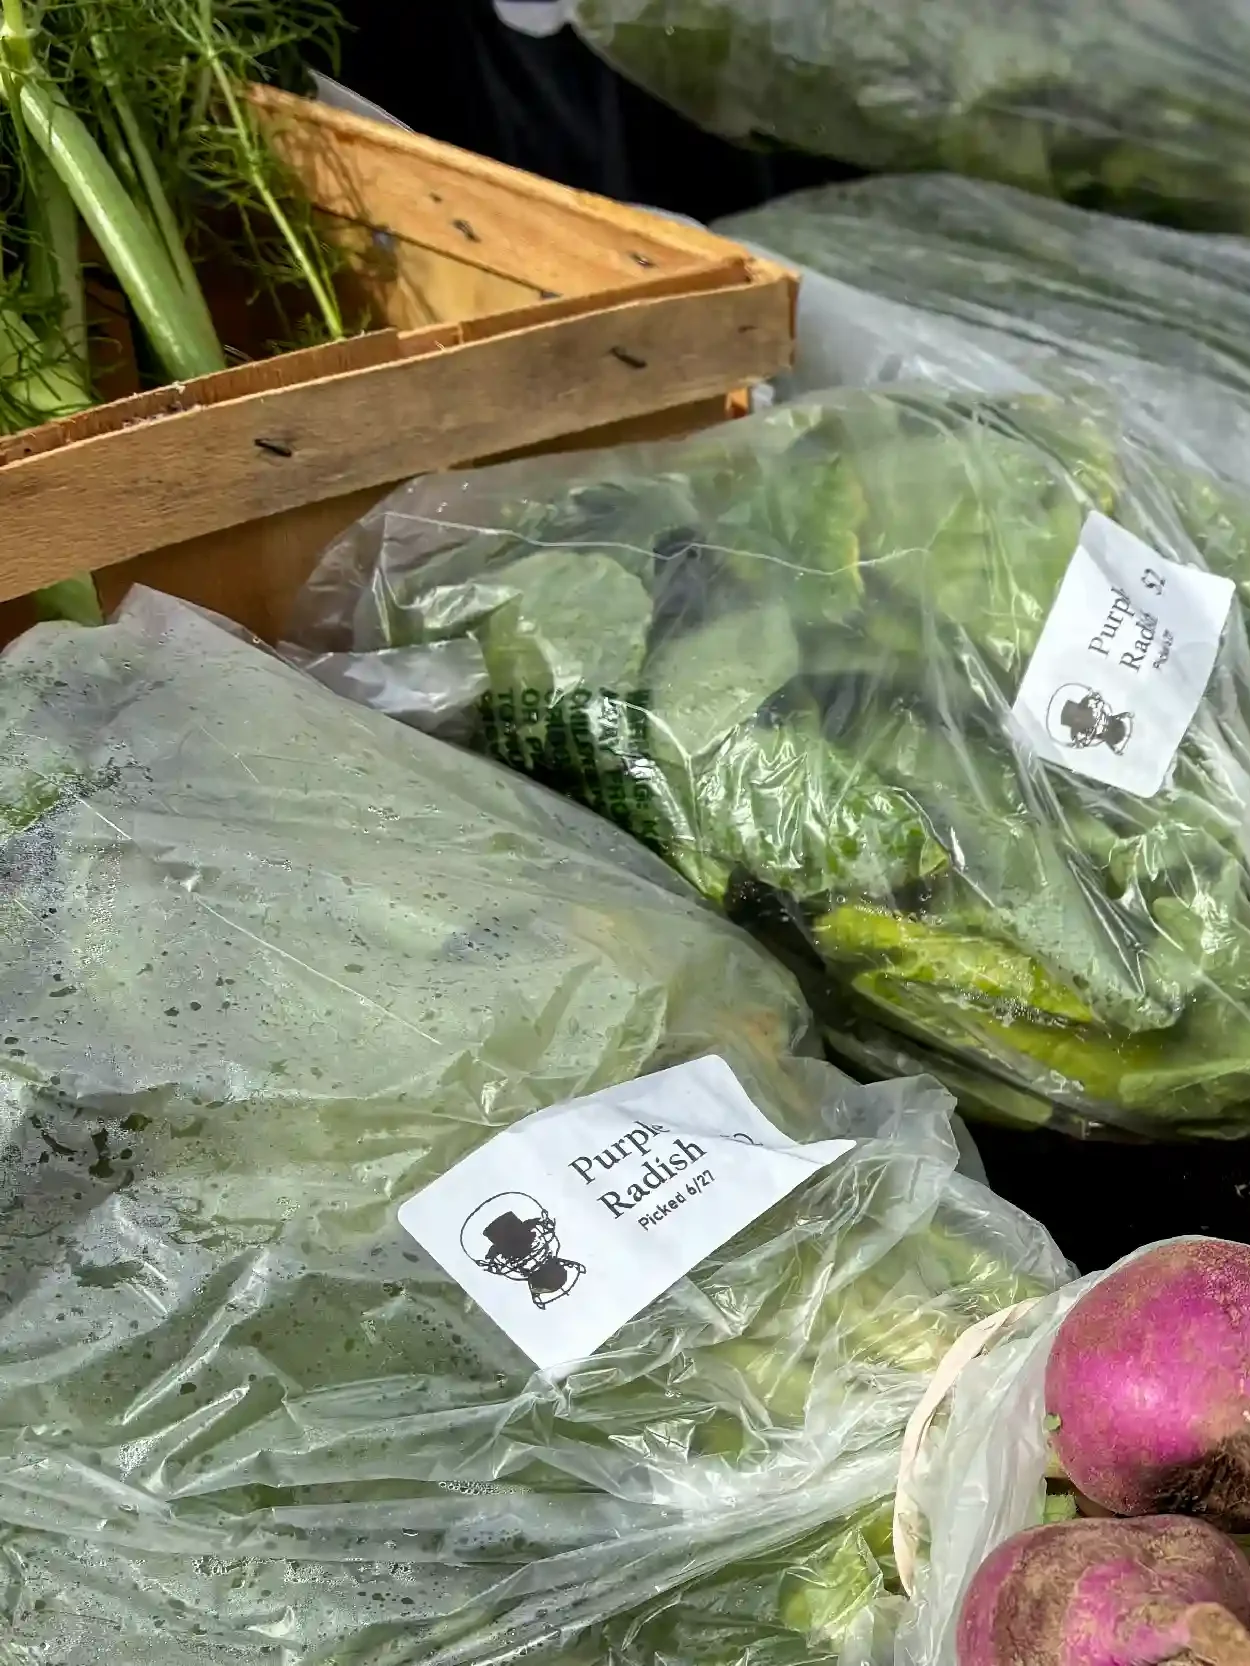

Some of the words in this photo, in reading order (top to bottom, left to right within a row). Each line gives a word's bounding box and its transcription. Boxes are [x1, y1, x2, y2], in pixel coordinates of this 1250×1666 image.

[1088, 586, 1135, 657] Purpl
[568, 1120, 671, 1186] Purple
[596, 1138, 708, 1220] Radish
[637, 1191, 687, 1231] Picked
[685, 1169, 716, 1196] 6/27
